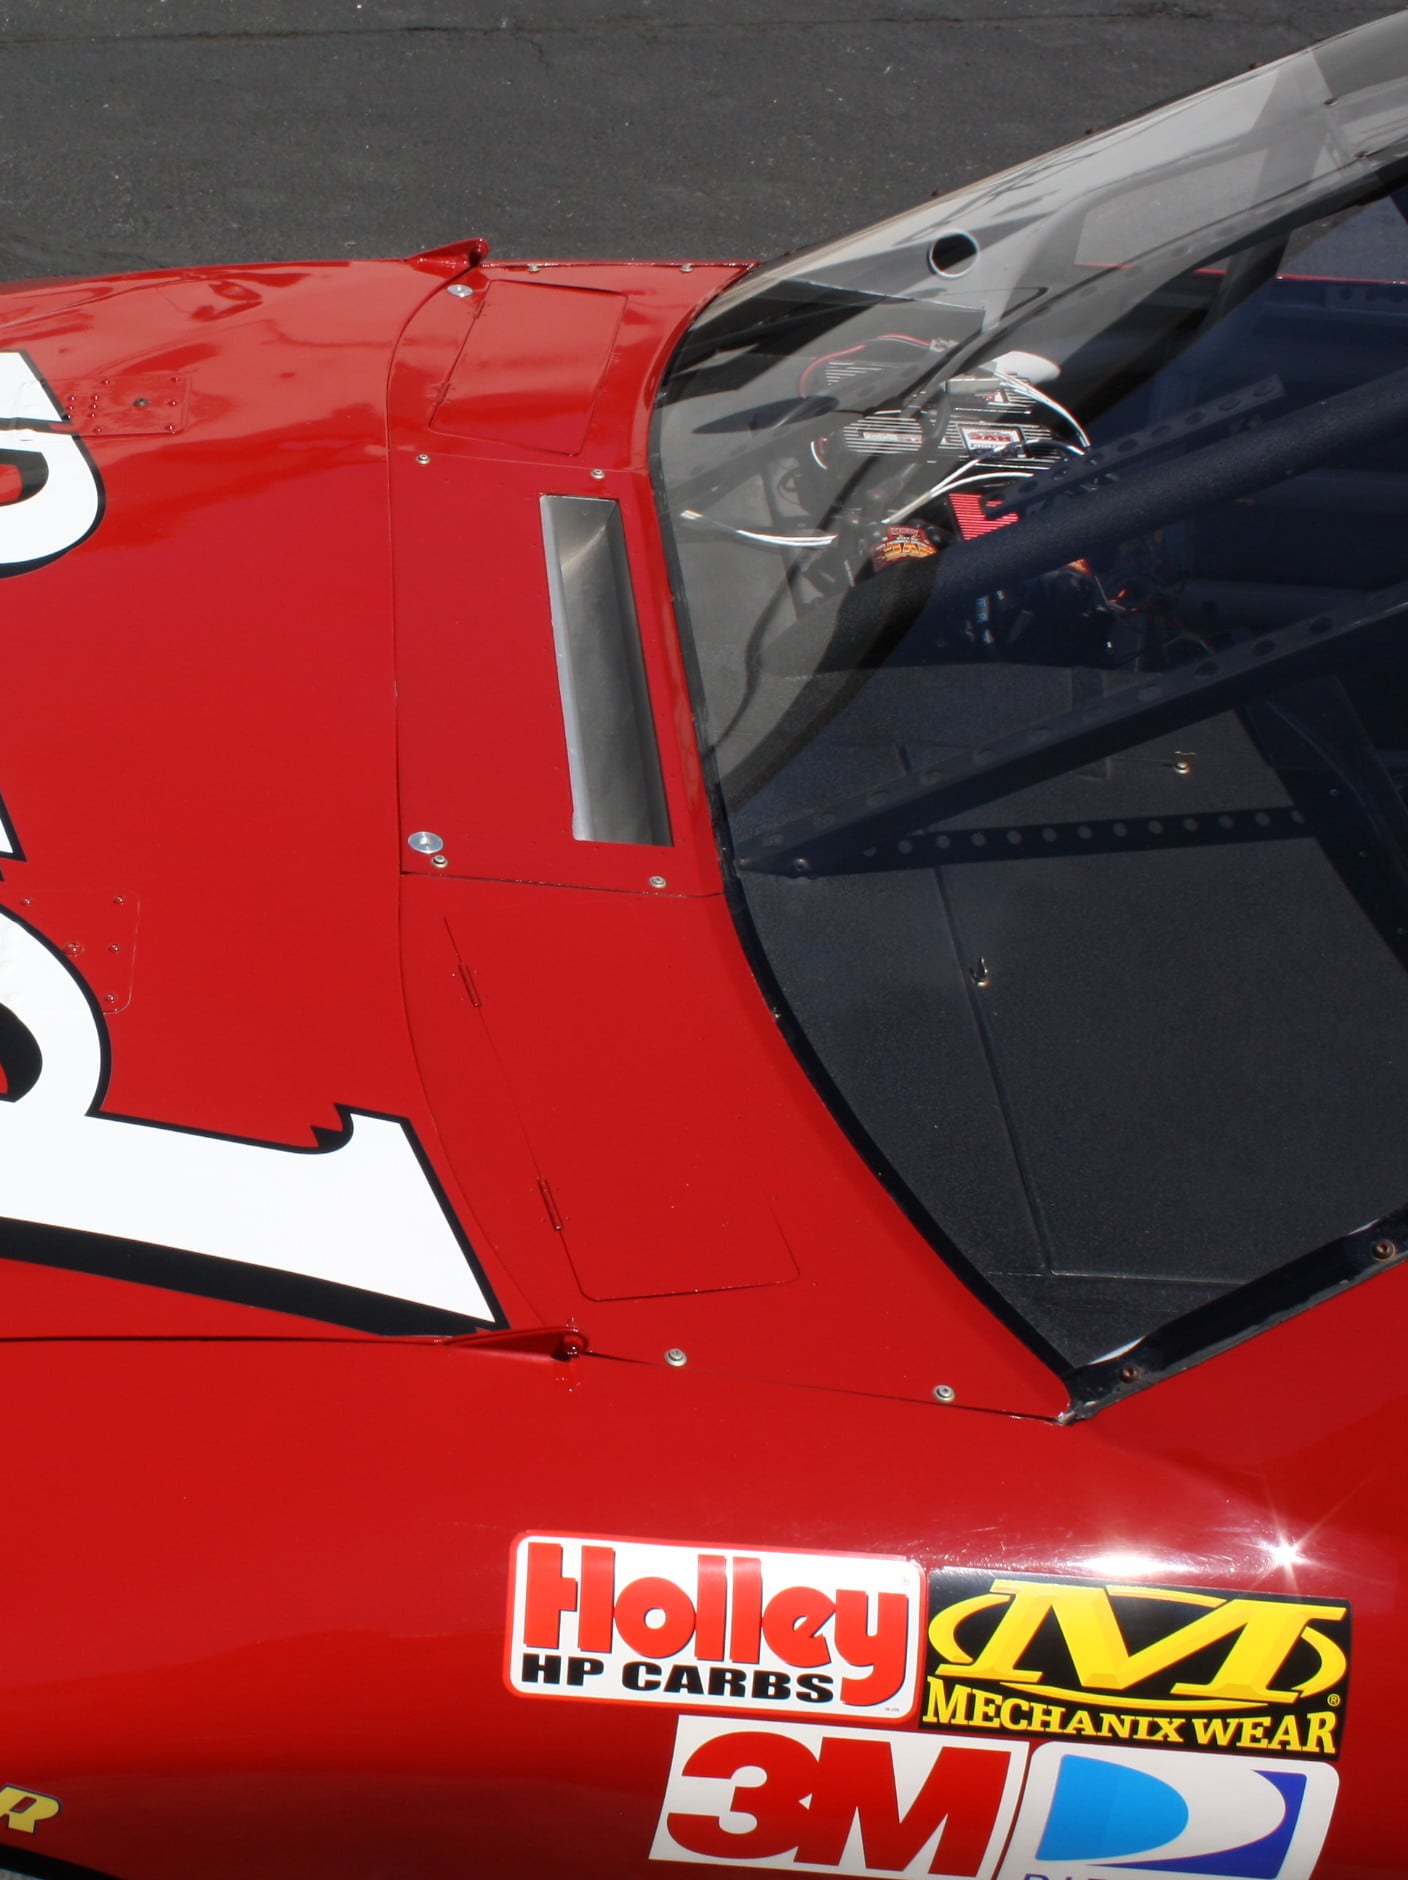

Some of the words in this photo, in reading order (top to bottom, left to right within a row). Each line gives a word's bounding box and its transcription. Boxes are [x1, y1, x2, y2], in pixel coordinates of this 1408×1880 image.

[521, 1652, 604, 1686] HP
[621, 1659, 835, 1704] CARBS
[523, 1541, 910, 1707] Holley
[921, 1675, 1188, 1743] MECHANIX
[1190, 1710, 1338, 1755] WEAR
[666, 1730, 1012, 1878] 3M
